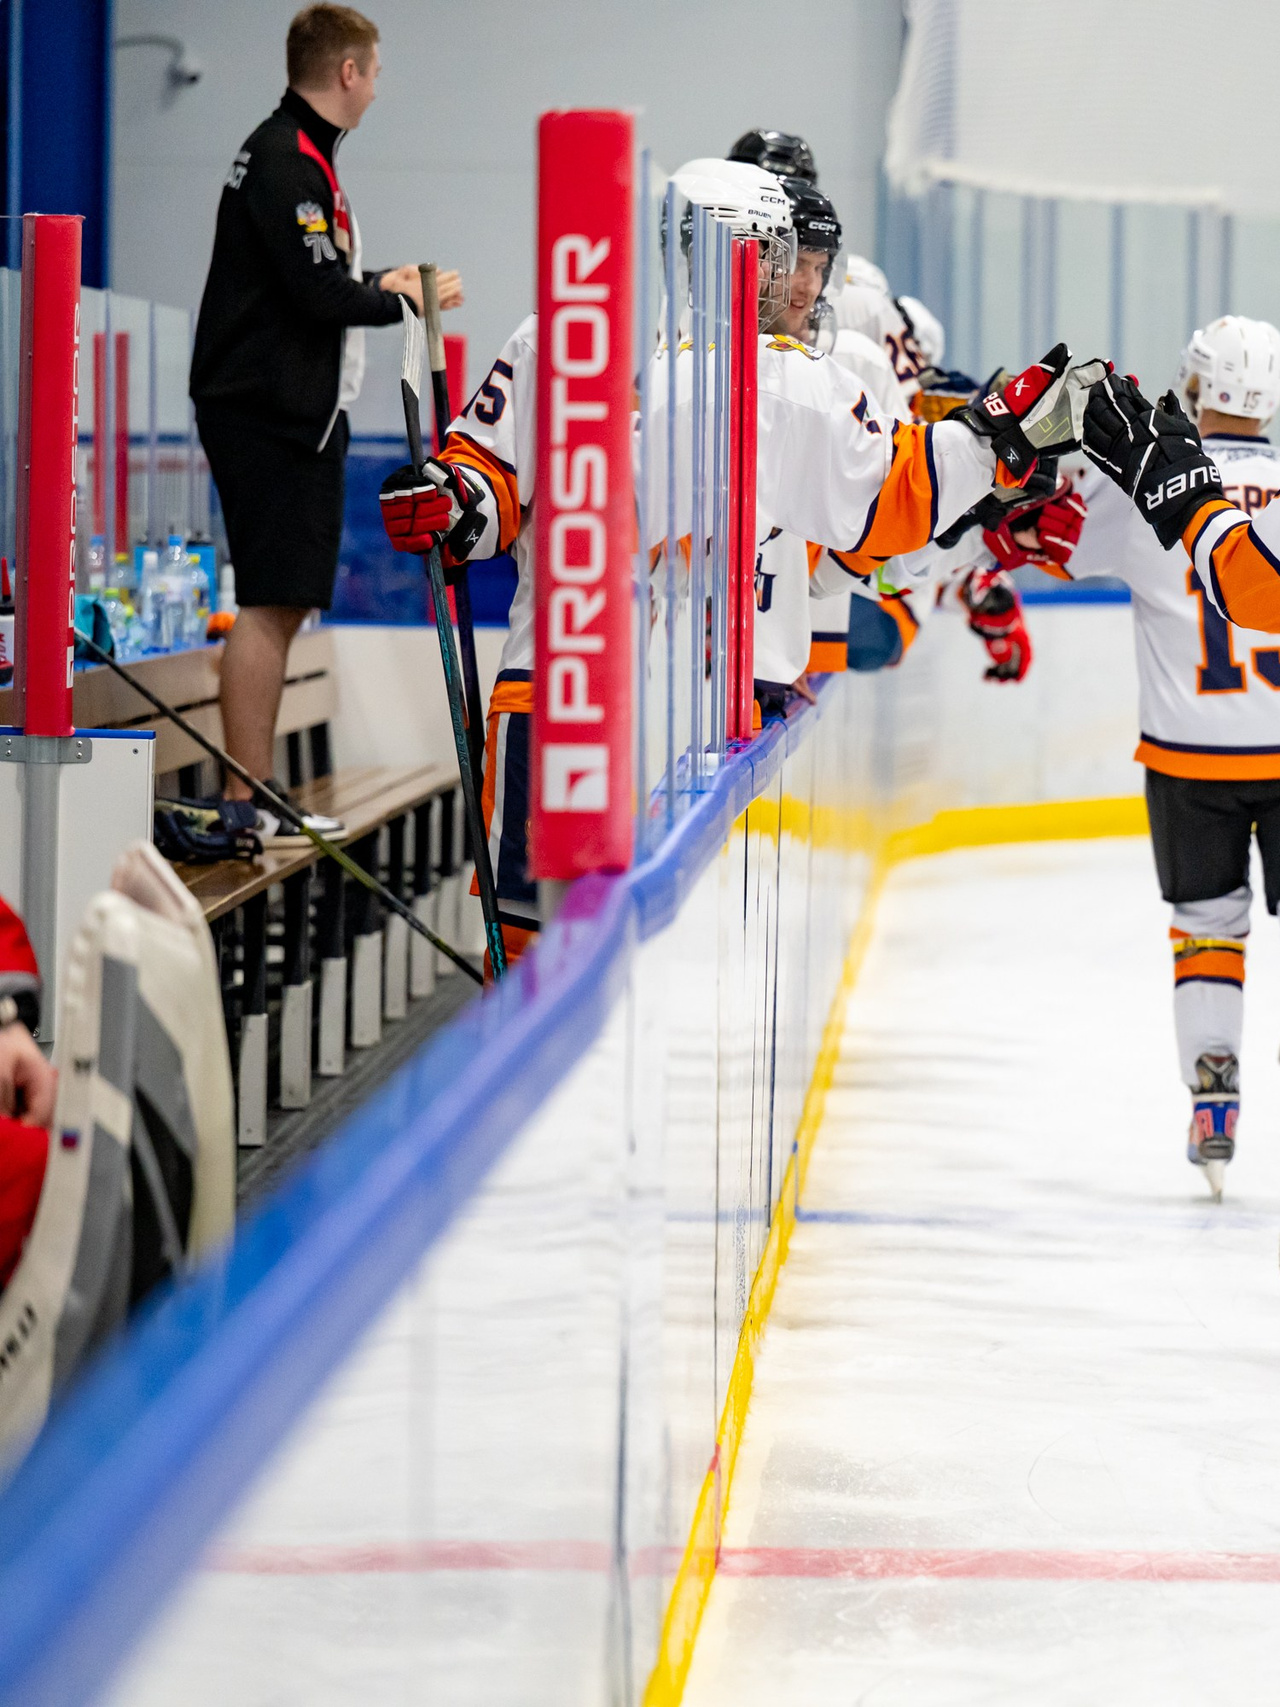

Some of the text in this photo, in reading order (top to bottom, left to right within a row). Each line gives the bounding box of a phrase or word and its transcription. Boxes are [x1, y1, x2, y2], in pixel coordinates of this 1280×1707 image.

[761, 195, 785, 205] CCM
[808, 220, 837, 232] CCM
[1244, 391, 1262, 410] 15
[547, 233, 612, 724] PROSTOR
